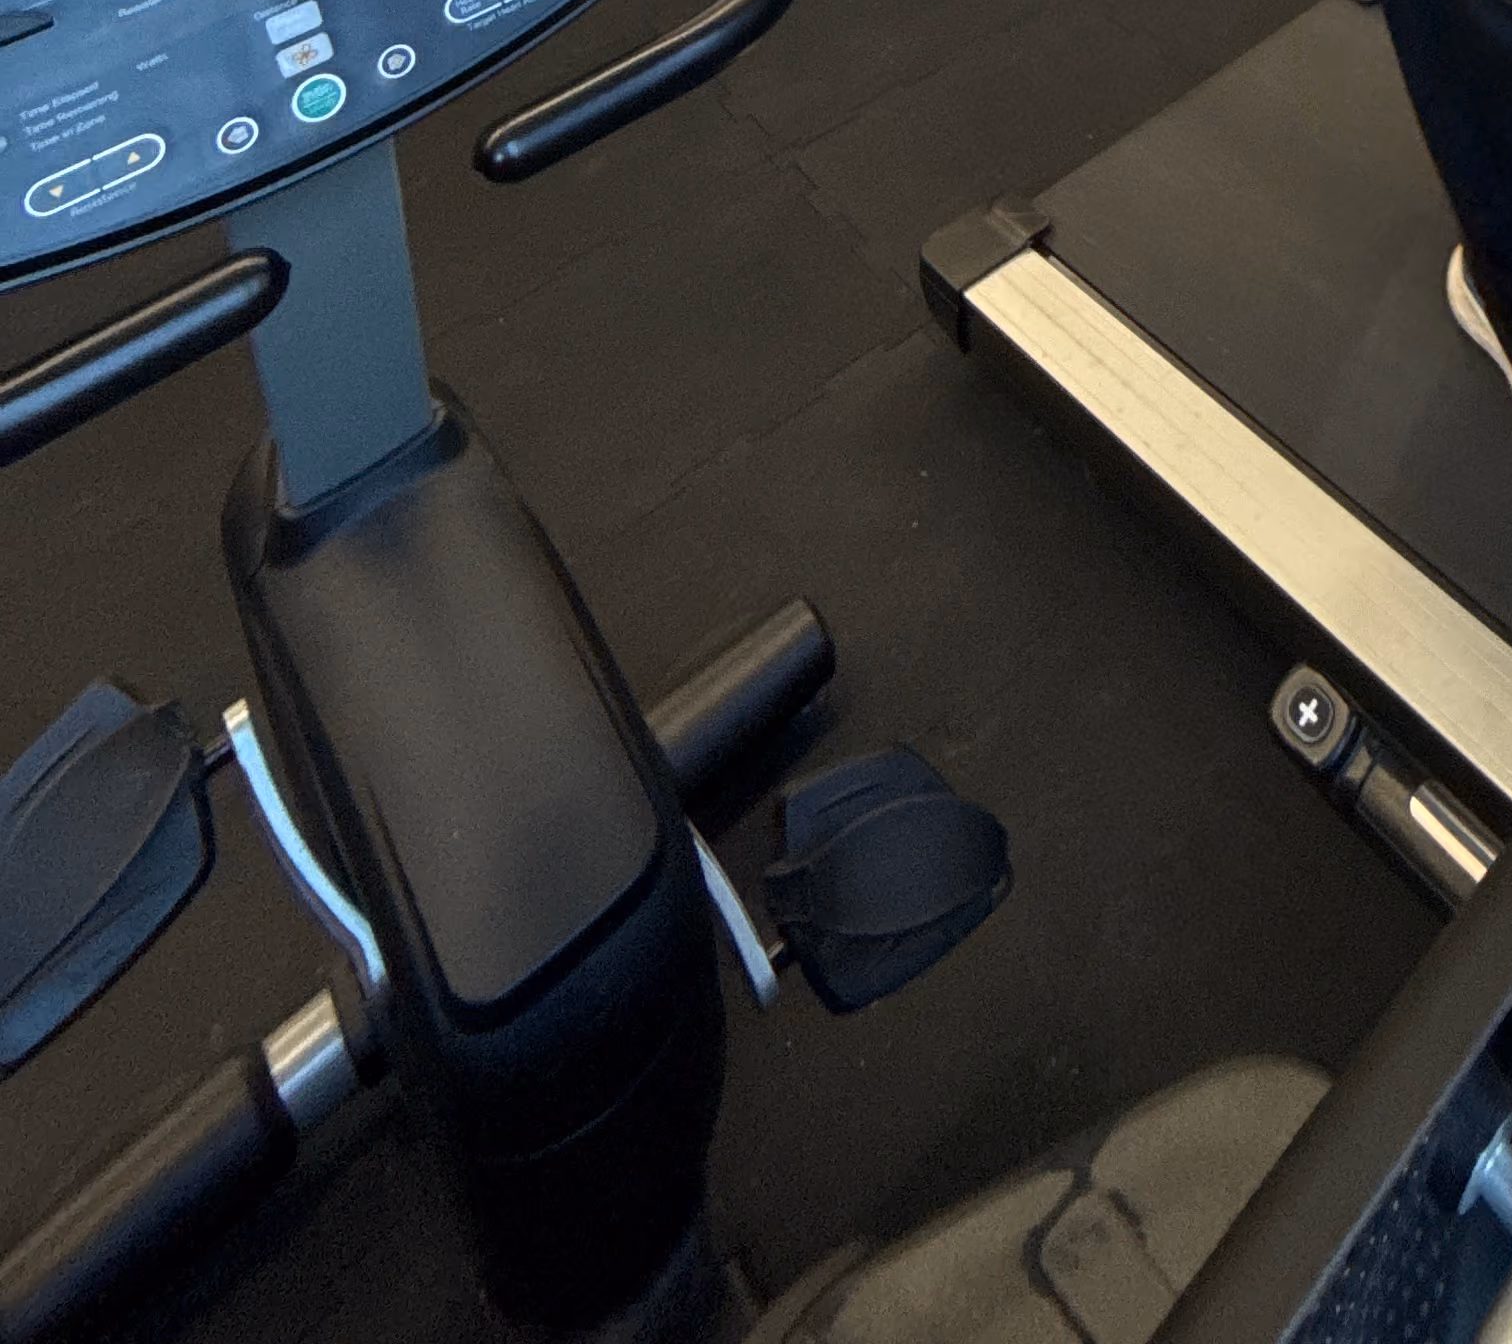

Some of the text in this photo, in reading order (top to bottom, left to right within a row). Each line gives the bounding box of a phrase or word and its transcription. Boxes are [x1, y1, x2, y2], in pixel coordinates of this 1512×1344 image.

[460, 0, 482, 16] Rate
[467, 13, 497, 31] Target
[498, 0, 522, 18] Heart
